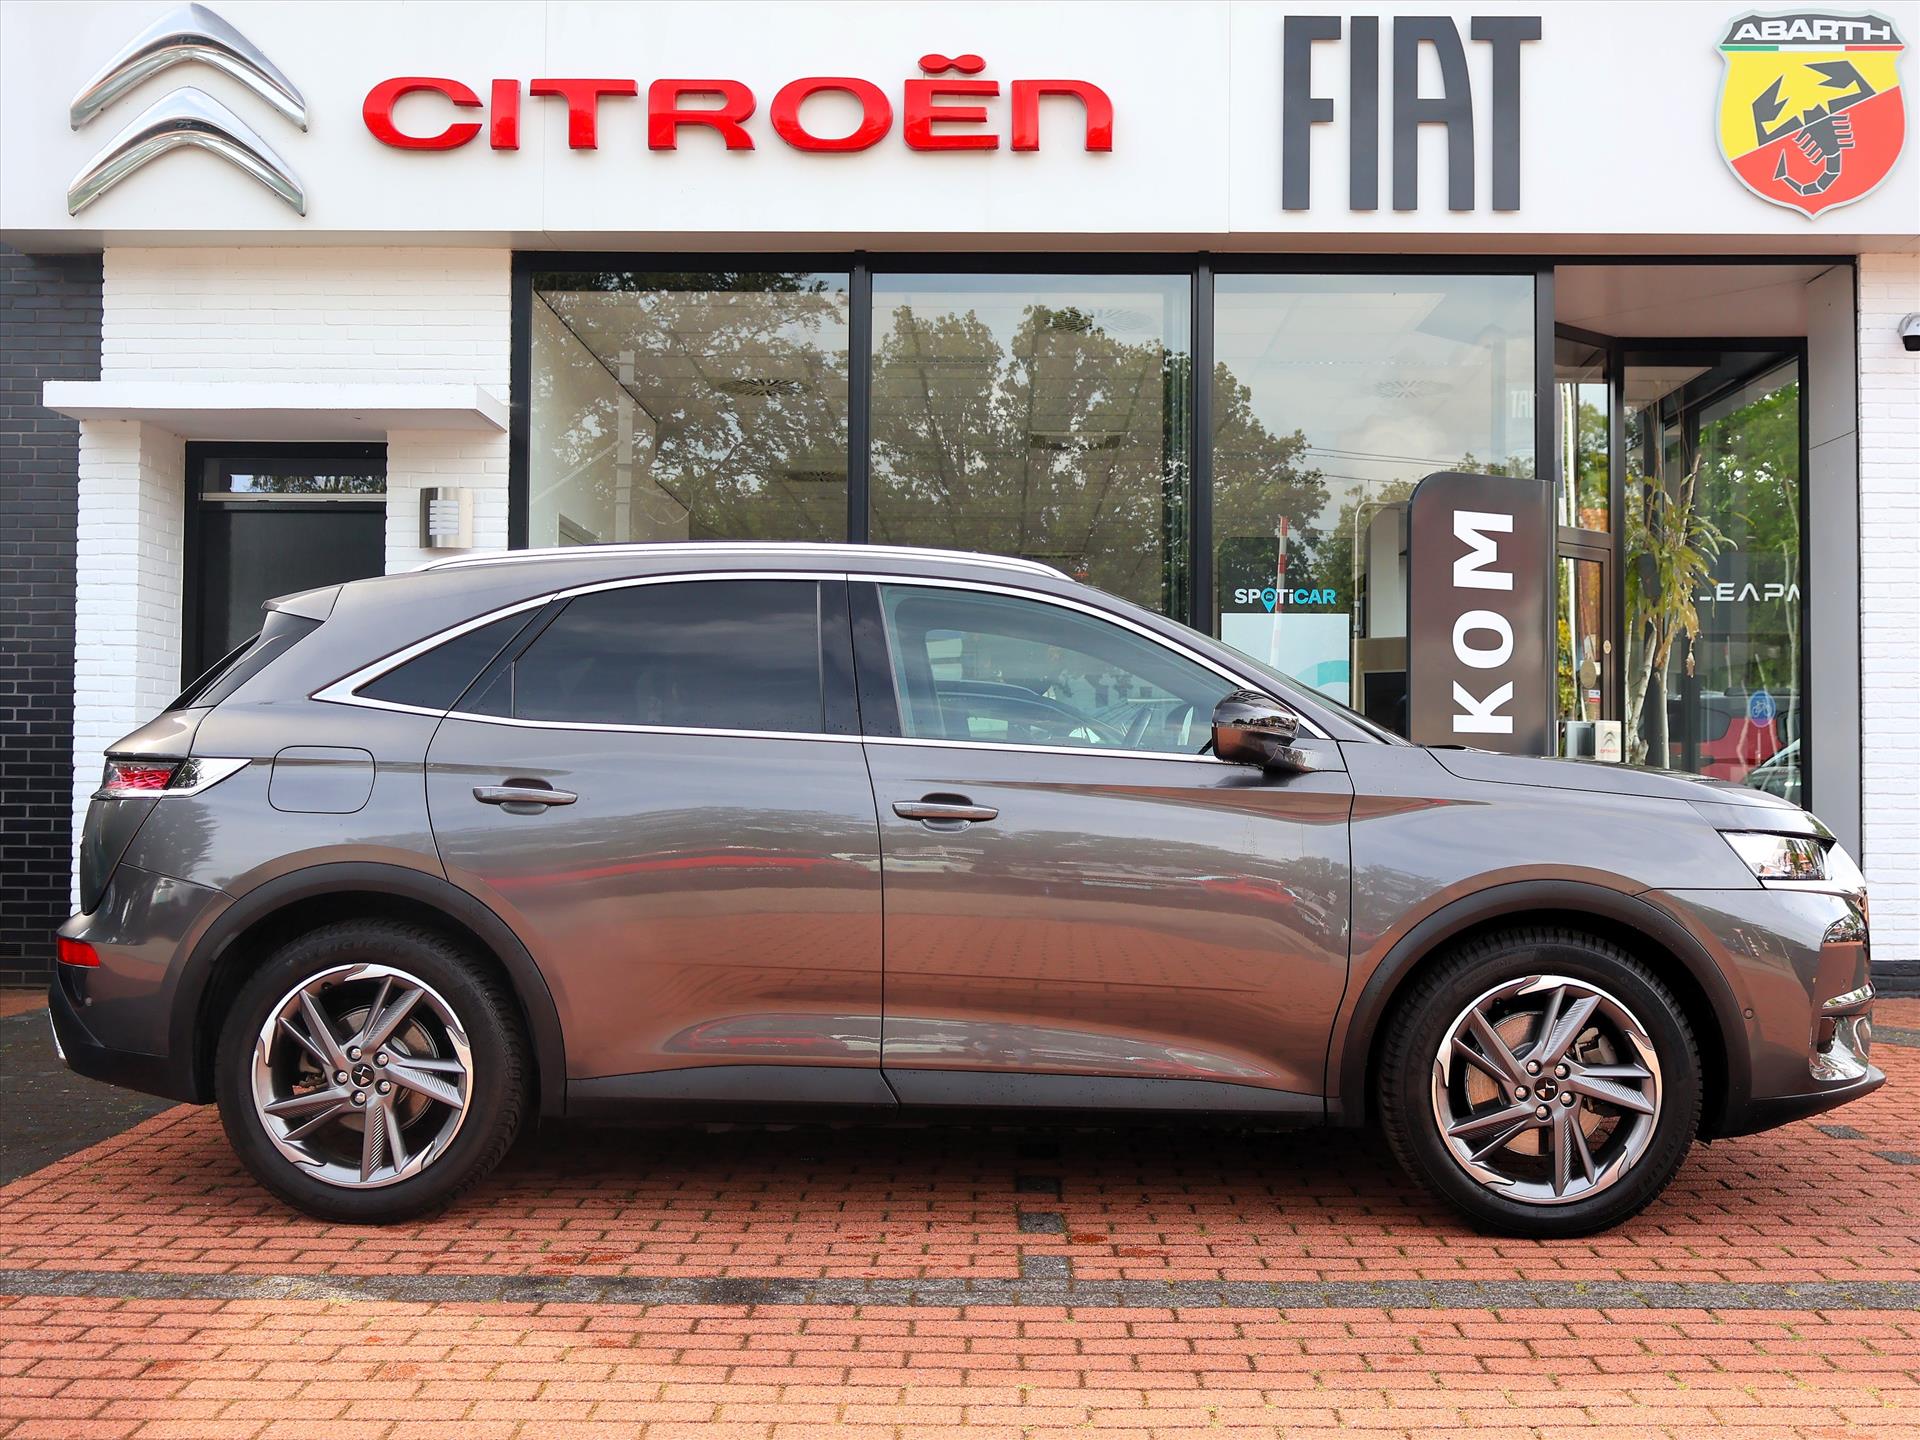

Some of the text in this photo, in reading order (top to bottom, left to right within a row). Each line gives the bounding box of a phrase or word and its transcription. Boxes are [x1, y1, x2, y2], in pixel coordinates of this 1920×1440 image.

[362, 53, 1115, 153] CITROËN
[1732, 19, 1891, 41] ABARTH
[1282, 15, 1542, 211] FIAT
[1452, 510, 1514, 734] KOM
